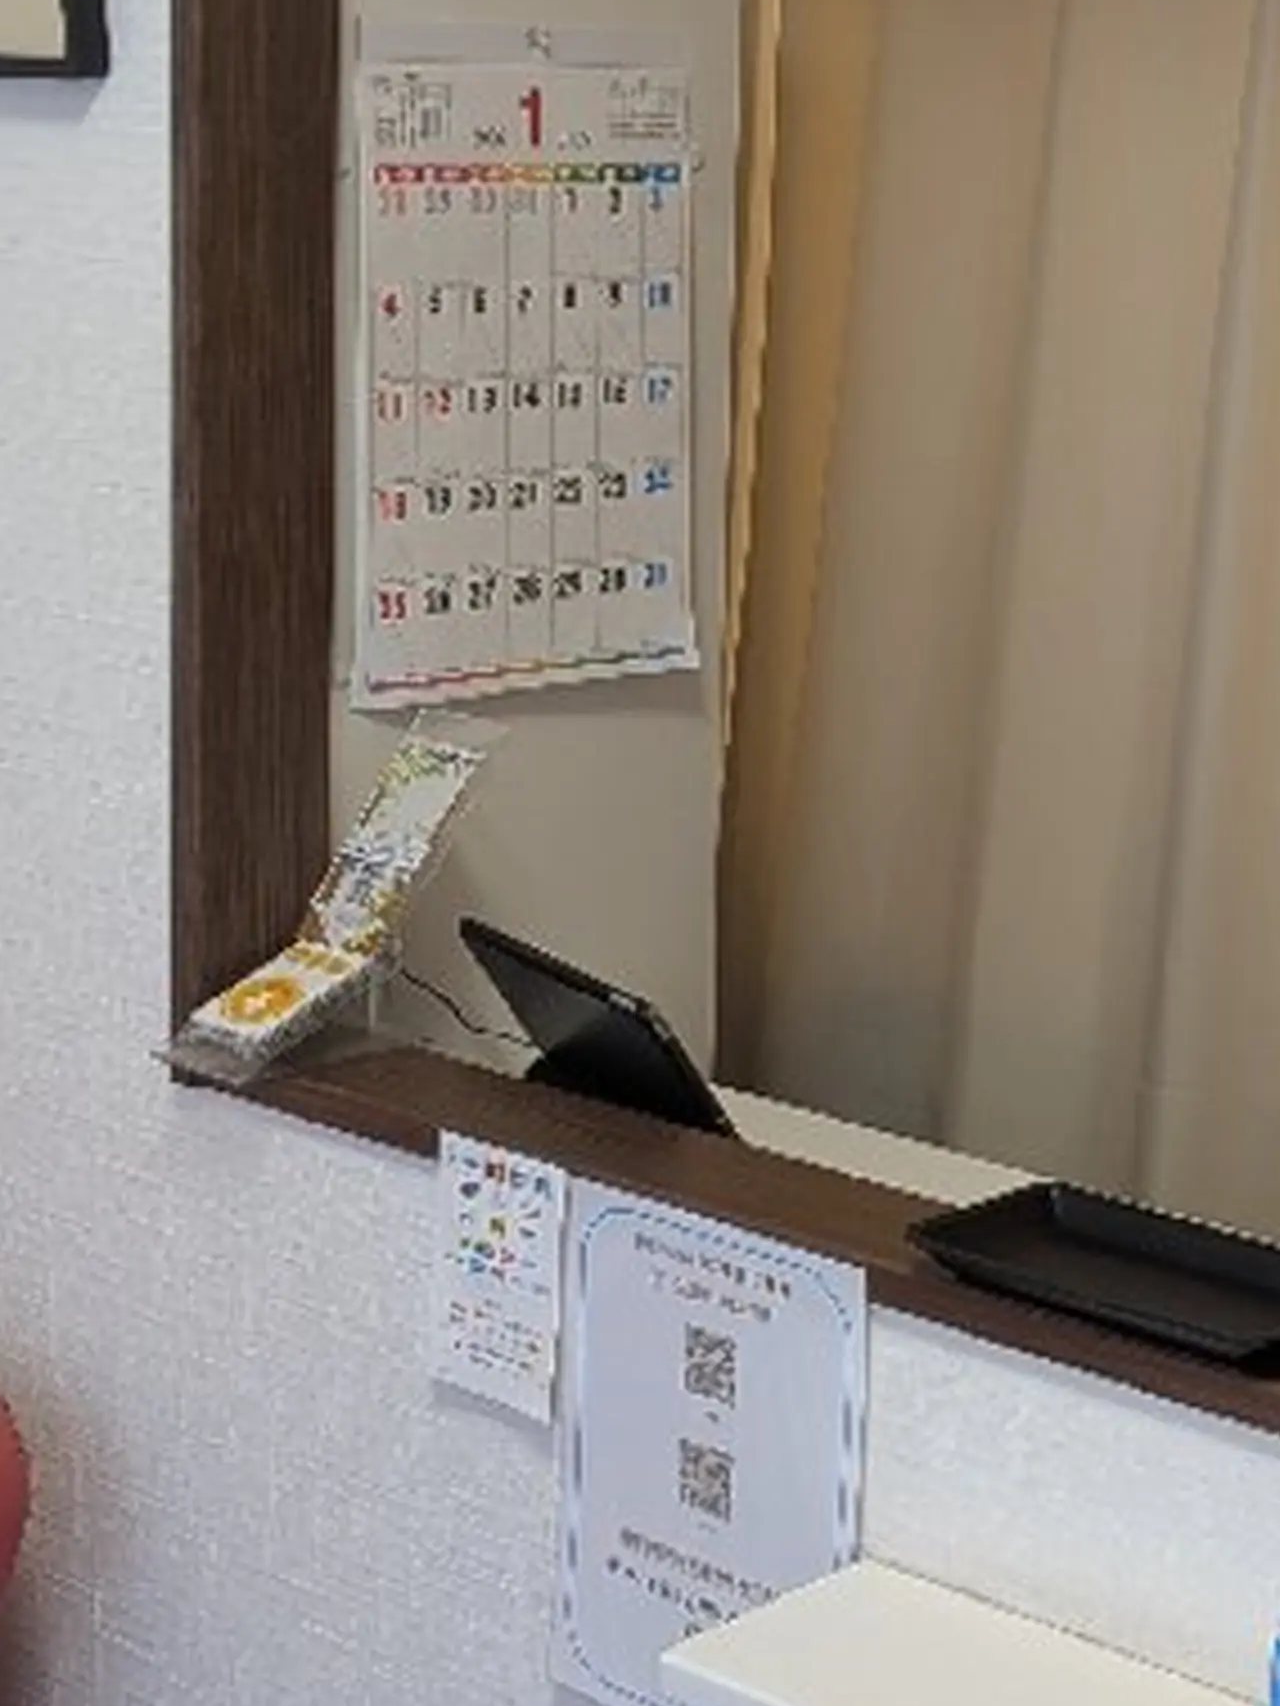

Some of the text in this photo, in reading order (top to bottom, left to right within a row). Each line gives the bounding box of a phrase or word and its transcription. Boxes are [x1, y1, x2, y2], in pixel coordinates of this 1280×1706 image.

[519, 87, 543, 147] 1
[566, 188, 577, 213] 1
[608, 188, 622, 214] 2
[382, 292, 400, 318] 4
[428, 287, 442, 314] 5
[517, 286, 533, 313] 7
[563, 283, 577, 308] 8
[607, 282, 622, 307] 9
[378, 378, 673, 420] 11 12 13 14 15 16 17
[378, 492, 407, 520] 18
[425, 486, 452, 514] 19
[467, 483, 497, 511] 20
[509, 482, 538, 509] 21
[378, 592, 407, 620] 25
[467, 576, 497, 610] 27
